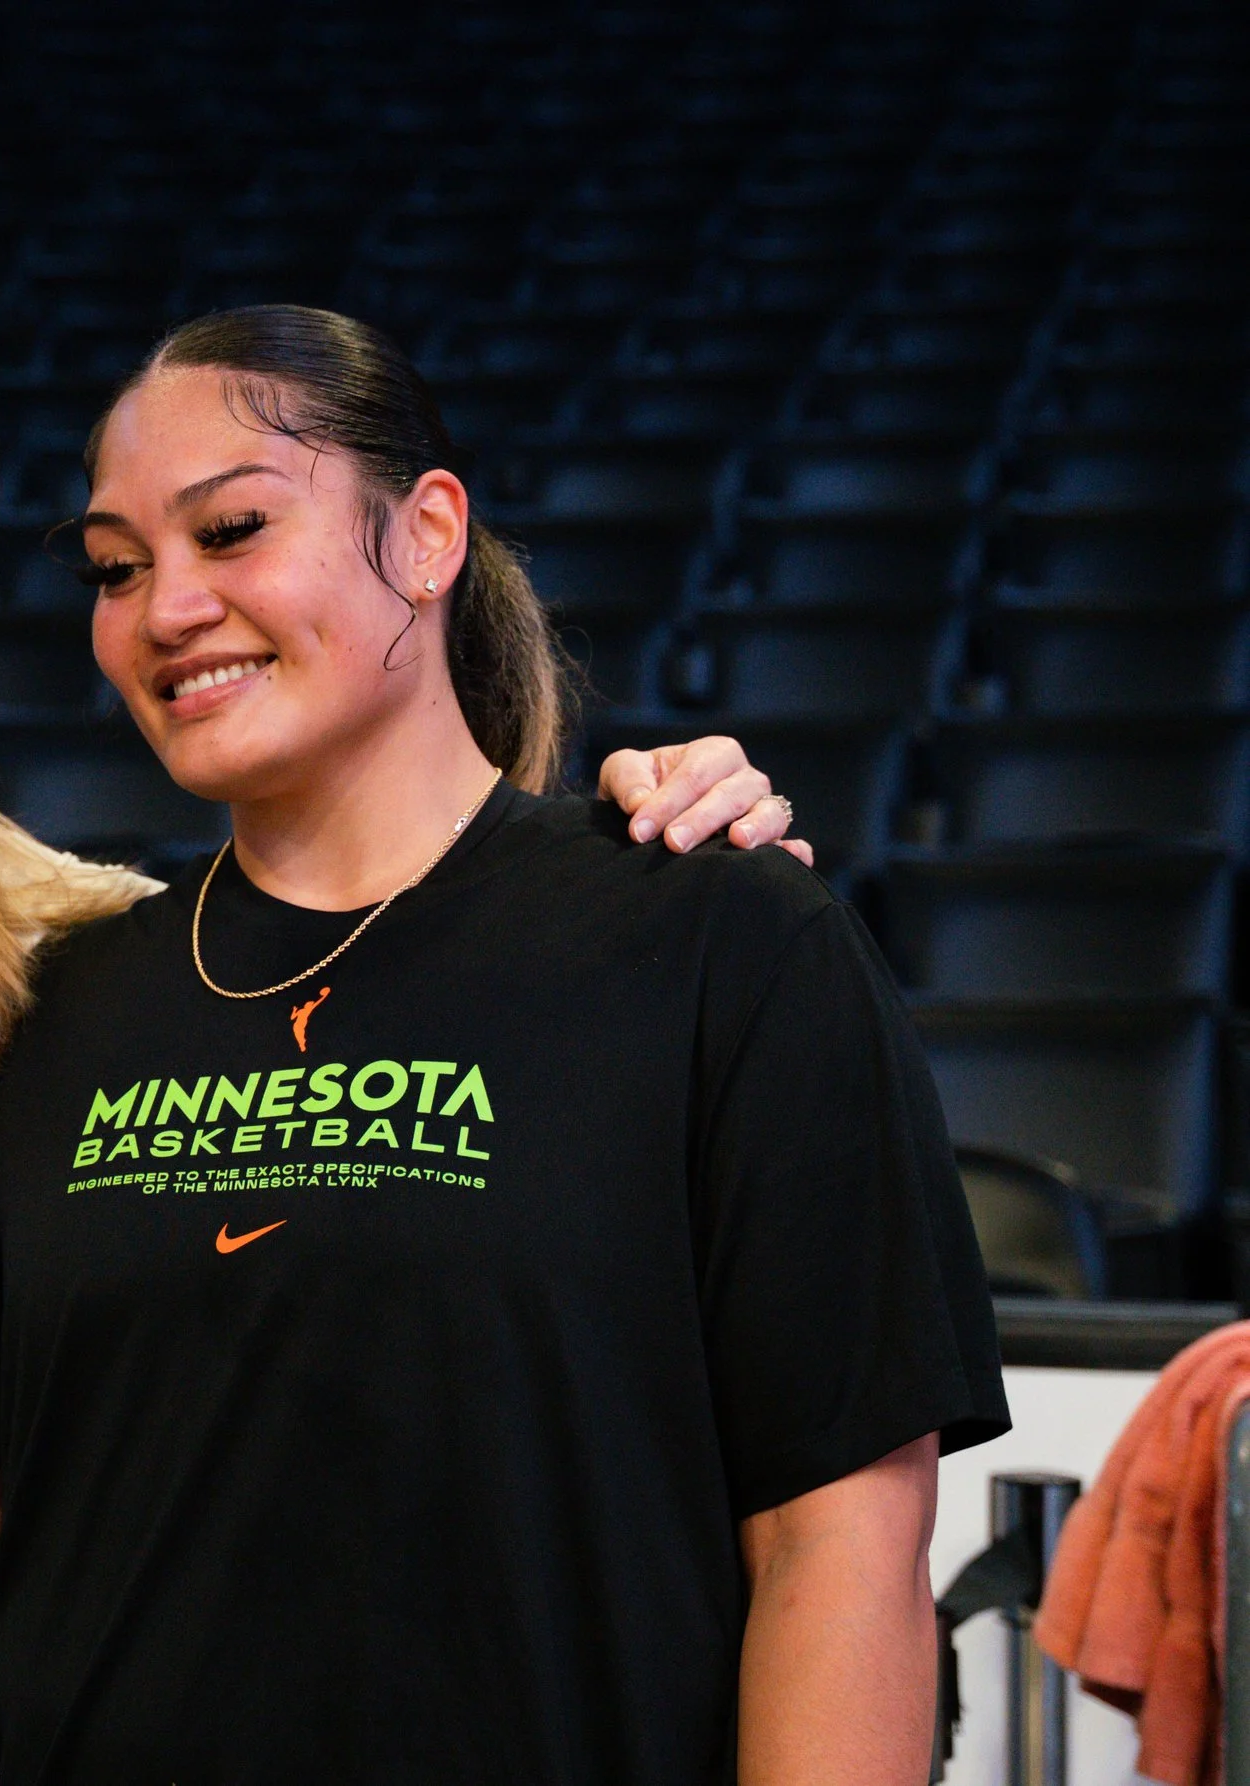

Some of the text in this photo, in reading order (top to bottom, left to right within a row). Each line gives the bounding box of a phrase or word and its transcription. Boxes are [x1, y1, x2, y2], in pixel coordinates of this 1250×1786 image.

[82, 1060, 495, 1136] MINNESOTA
[73, 1118, 491, 1169] BASKETBALL
[66, 1162, 486, 1194] ENGINEERED TO THE EXACT SPECIFICATIONS
[142, 1175, 378, 1195] OF THE MINNESOTA LYNX
